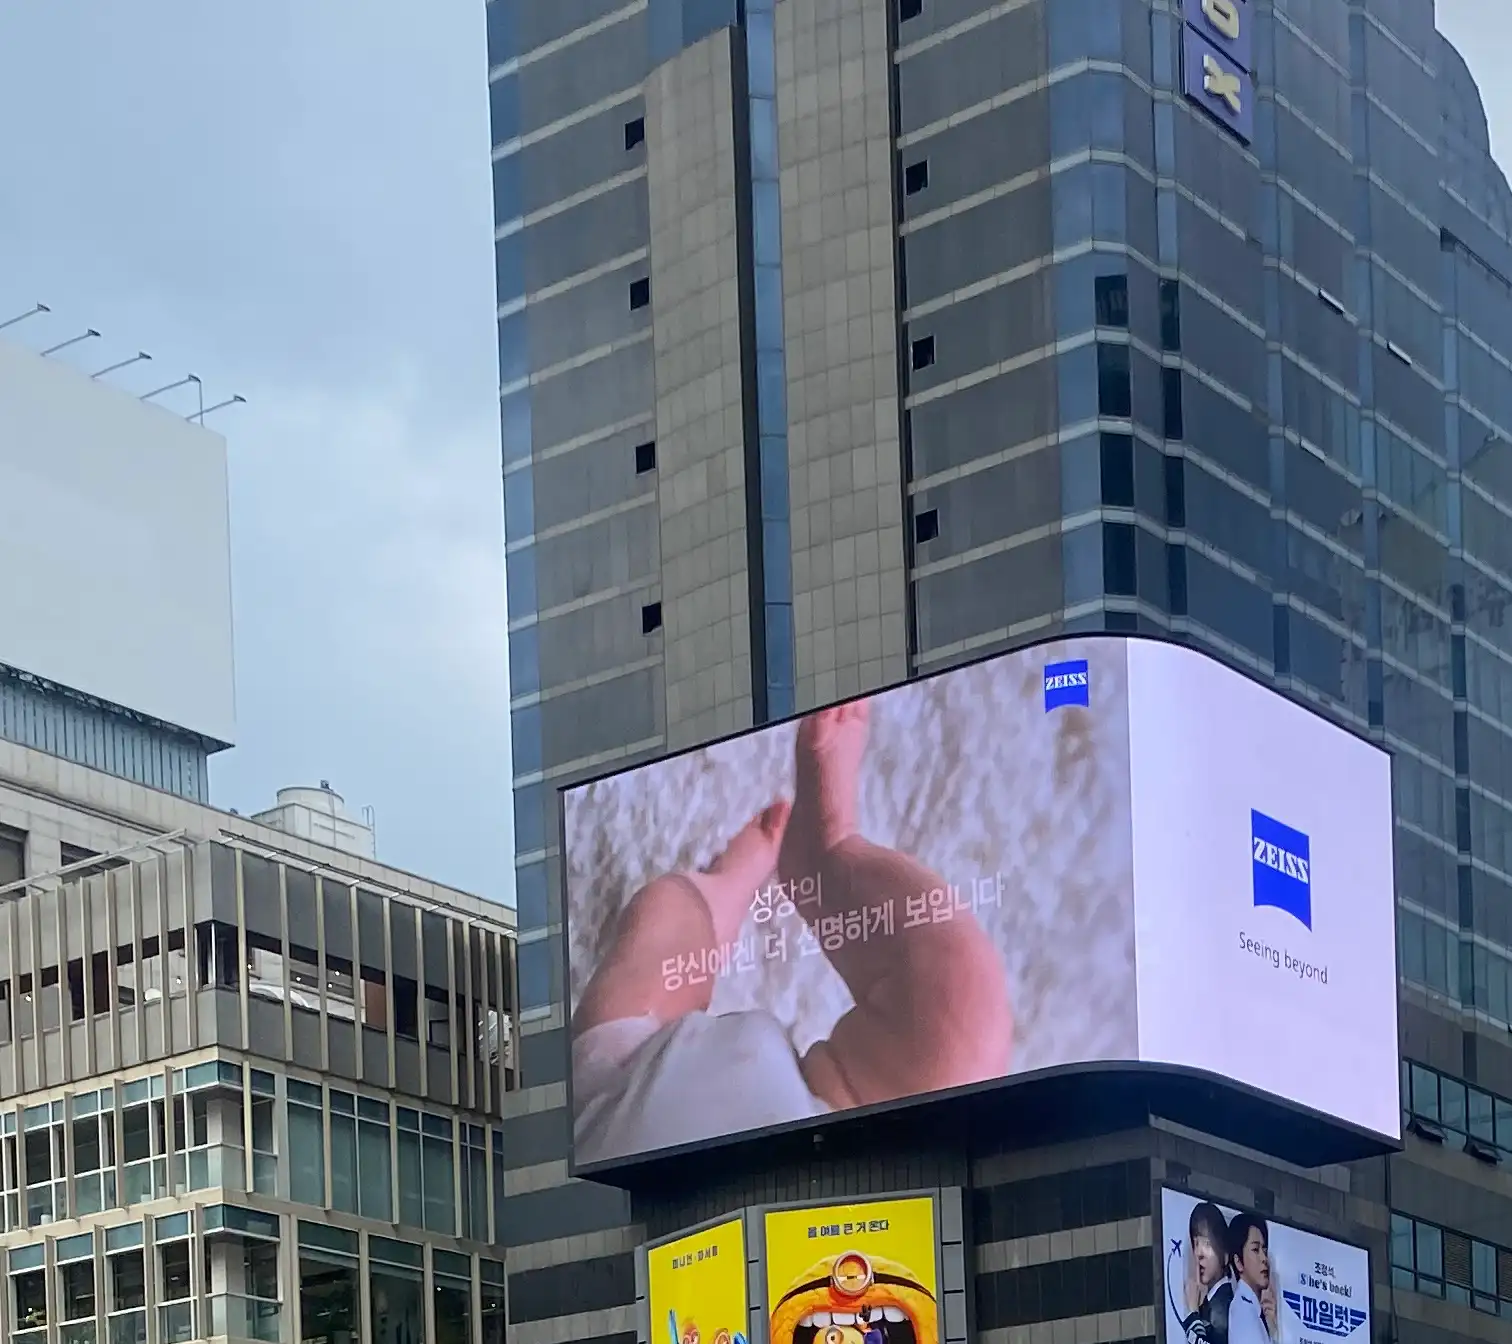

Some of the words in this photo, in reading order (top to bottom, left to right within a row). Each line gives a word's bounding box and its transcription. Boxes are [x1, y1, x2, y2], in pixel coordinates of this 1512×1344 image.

[1045, 671, 1088, 691] ZEISS
[1253, 836, 1309, 884] ZEISS
[748, 872, 822, 923] 성장의
[661, 937, 756, 991] 당신에겐
[764, 930, 787, 962] 더
[798, 898, 895, 957] 선명하게
[903, 871, 1005, 929] 보입니다
[1239, 931, 1280, 969] Seeing
[1284, 948, 1328, 985] beyond
[1302, 1295, 1350, 1332] 파일럿
